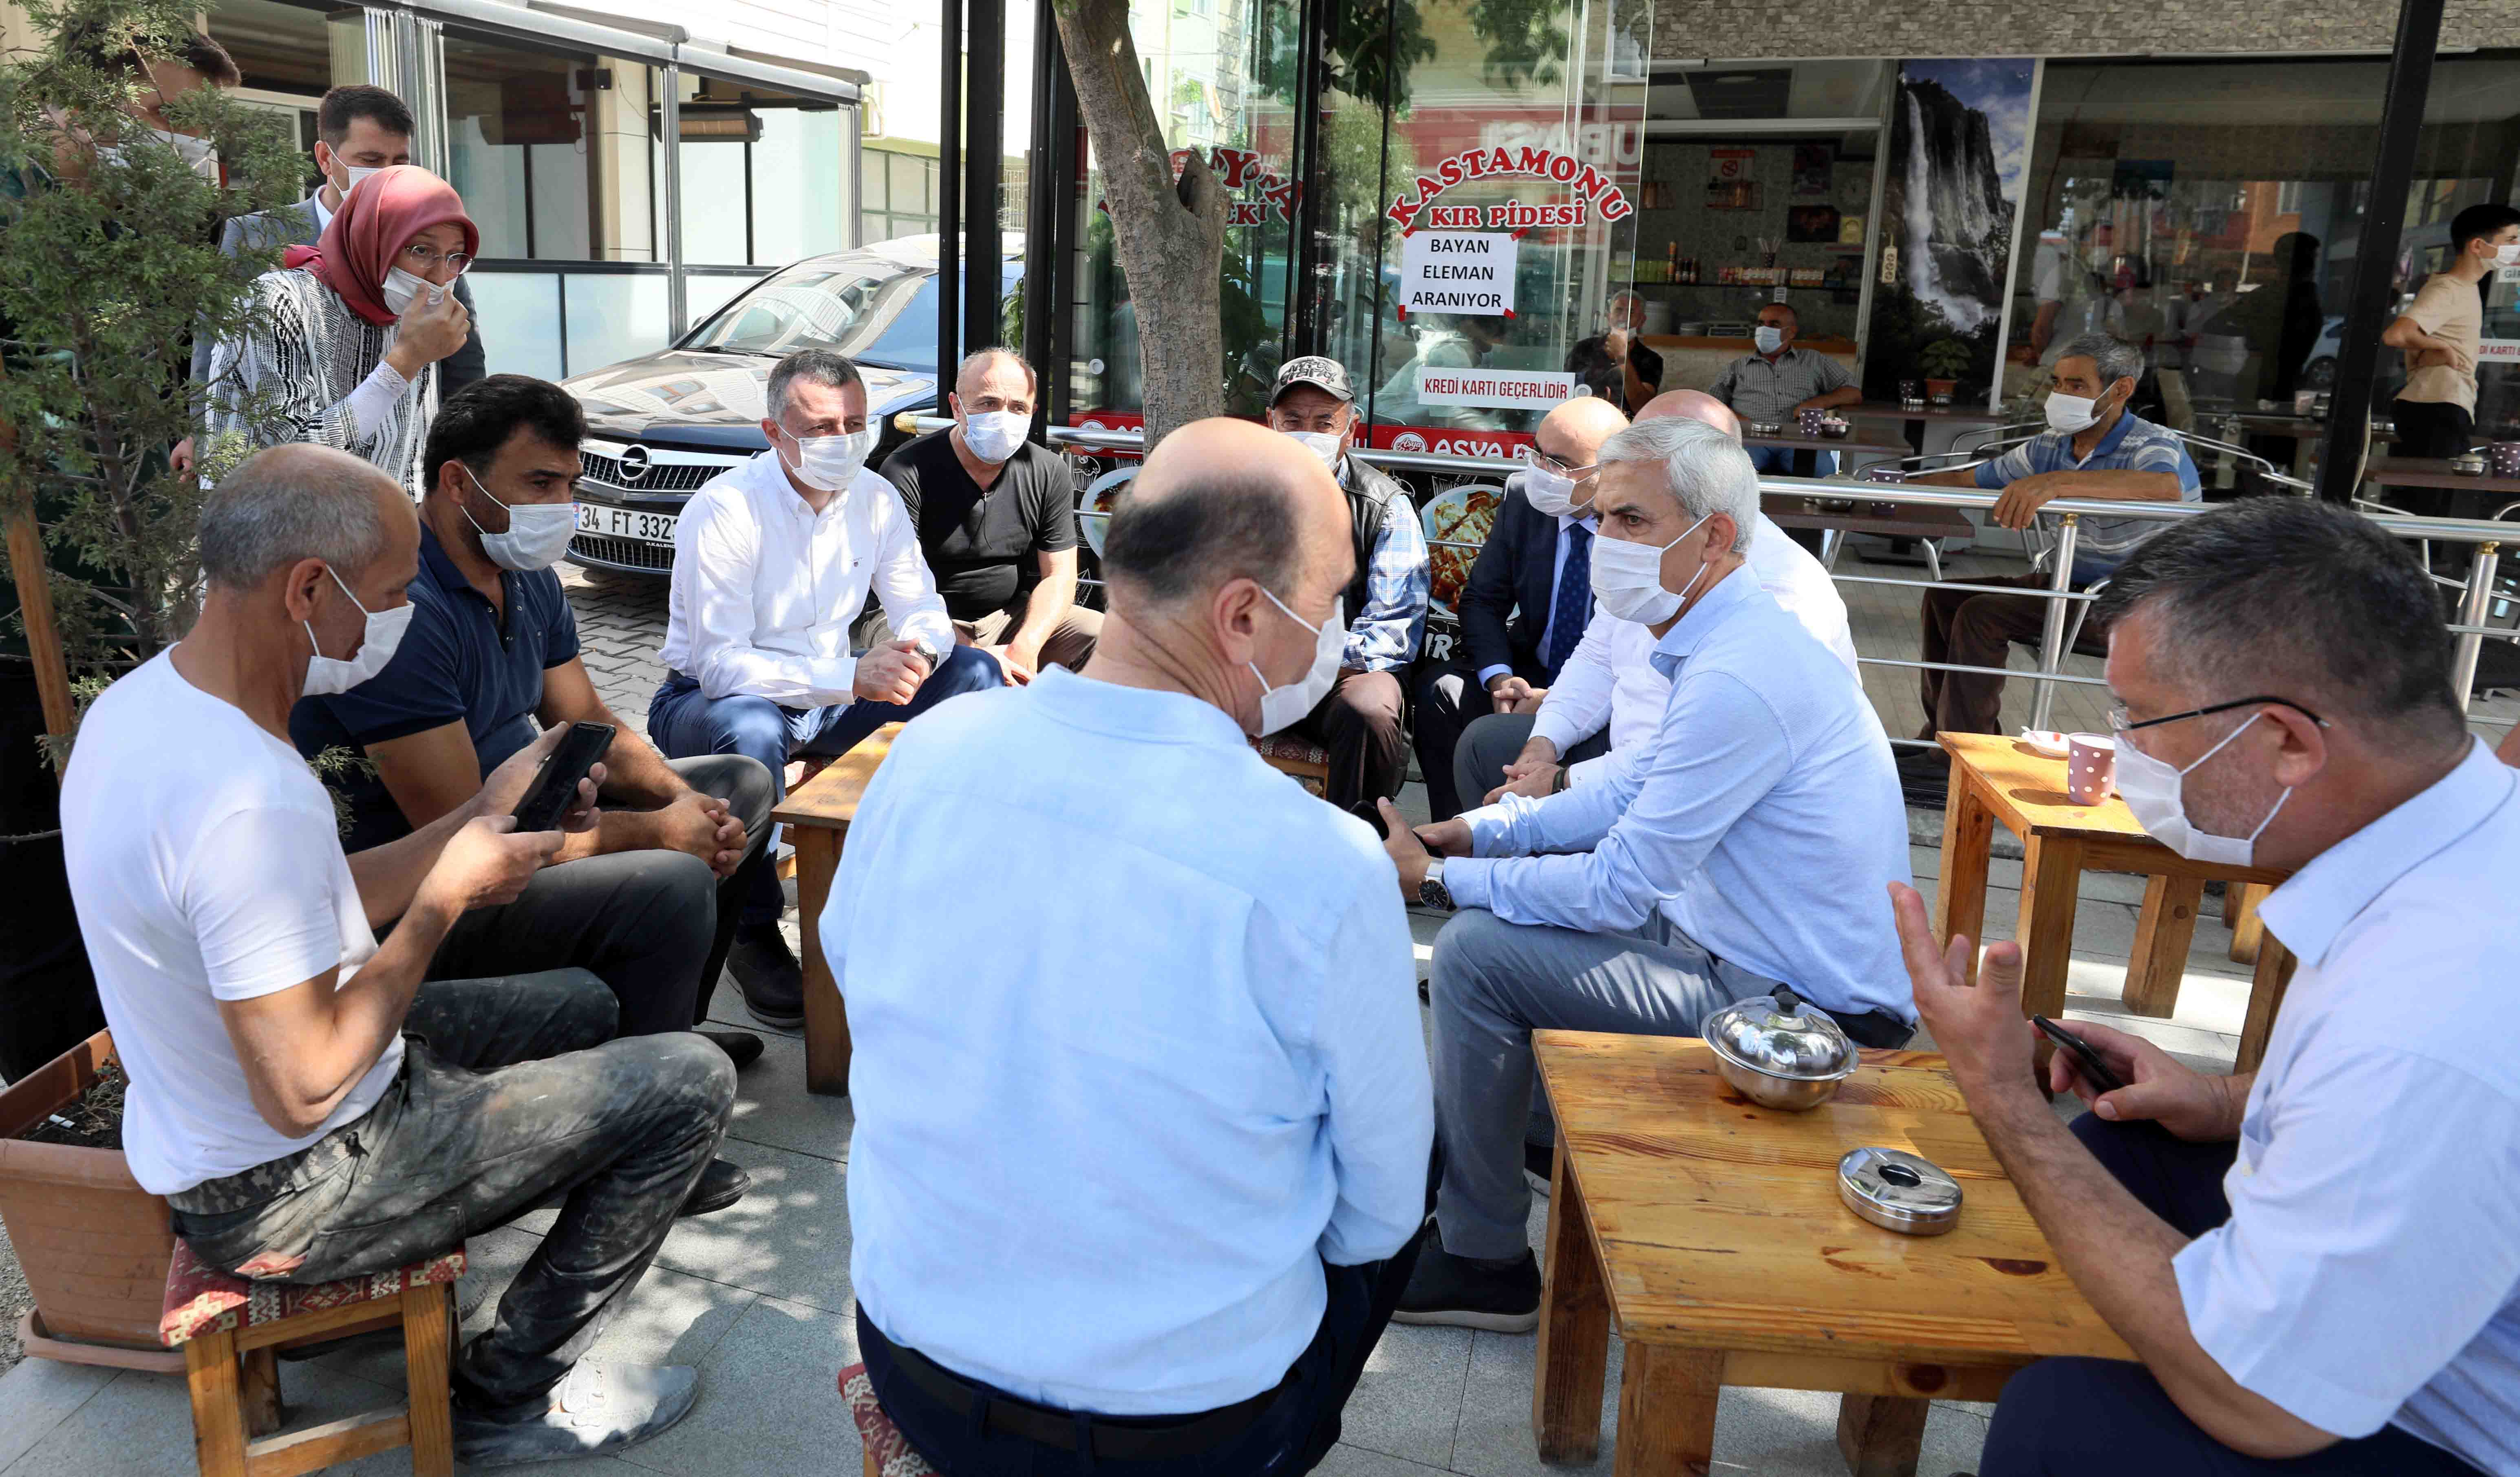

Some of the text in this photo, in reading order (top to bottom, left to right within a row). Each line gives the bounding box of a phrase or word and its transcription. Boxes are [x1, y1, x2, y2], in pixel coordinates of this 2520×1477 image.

[1387, 146, 1632, 228] KASTAMONU
[1430, 199, 1587, 227] KIR PİDESİ
[1430, 239, 1489, 254] BAYAN
[1423, 265, 1494, 280] ELEMAN
[1412, 291, 1501, 308] ARANIYOR
[1425, 377, 1568, 400] KREDİ KARTI GEÇERLİDİR
[1434, 439, 1503, 457] ASYA
[582, 507, 600, 530] 34
[612, 511, 632, 534] FT
